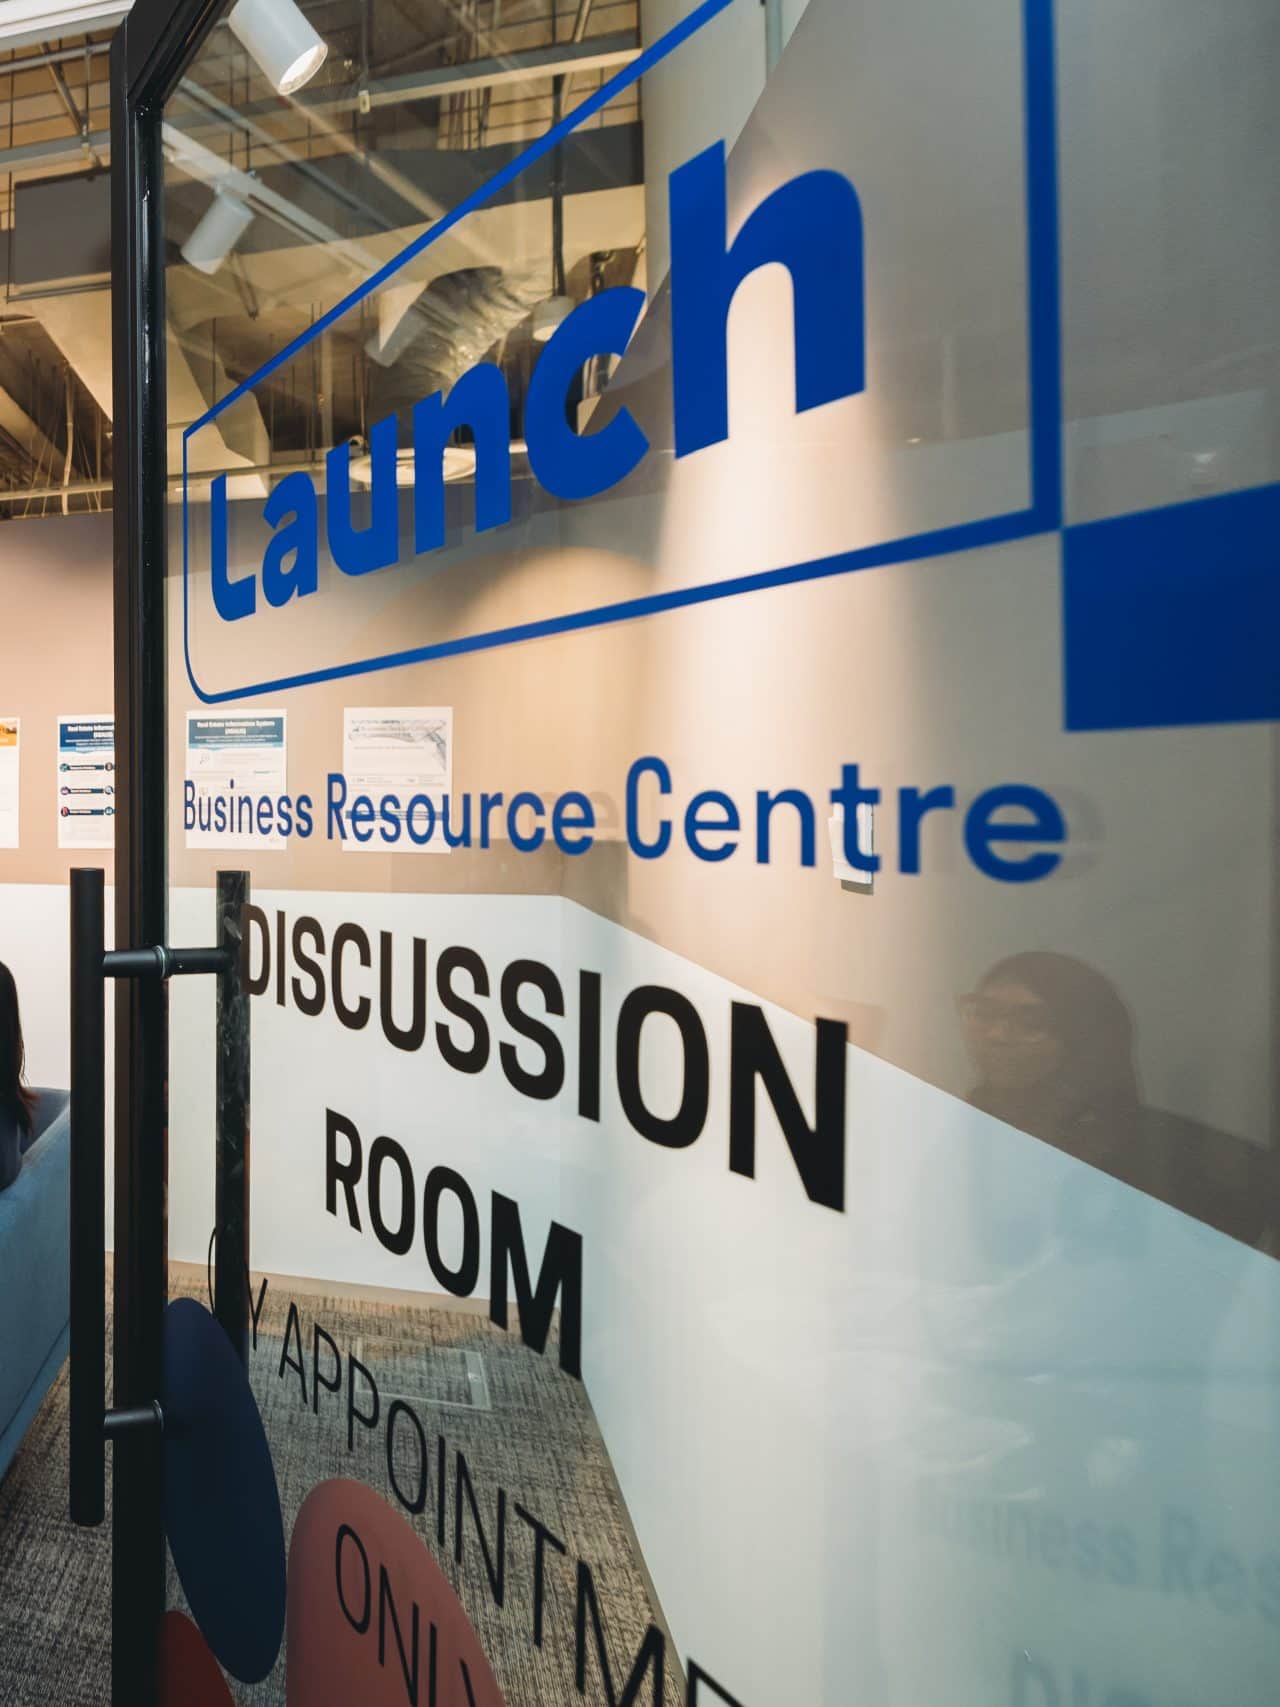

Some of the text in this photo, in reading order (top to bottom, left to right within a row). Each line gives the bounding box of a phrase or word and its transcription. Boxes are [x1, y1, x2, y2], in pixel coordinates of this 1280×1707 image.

[210, 139, 865, 622] Launch
[183, 777, 312, 838] Business
[325, 771, 595, 856] Resource
[625, 756, 1067, 883] Centre
[240, 902, 849, 1213] DISCUSSION
[326, 1108, 583, 1384] ROOM
[278, 1301, 757, 1707] APPOINTM
[334, 1522, 477, 1707] ON
